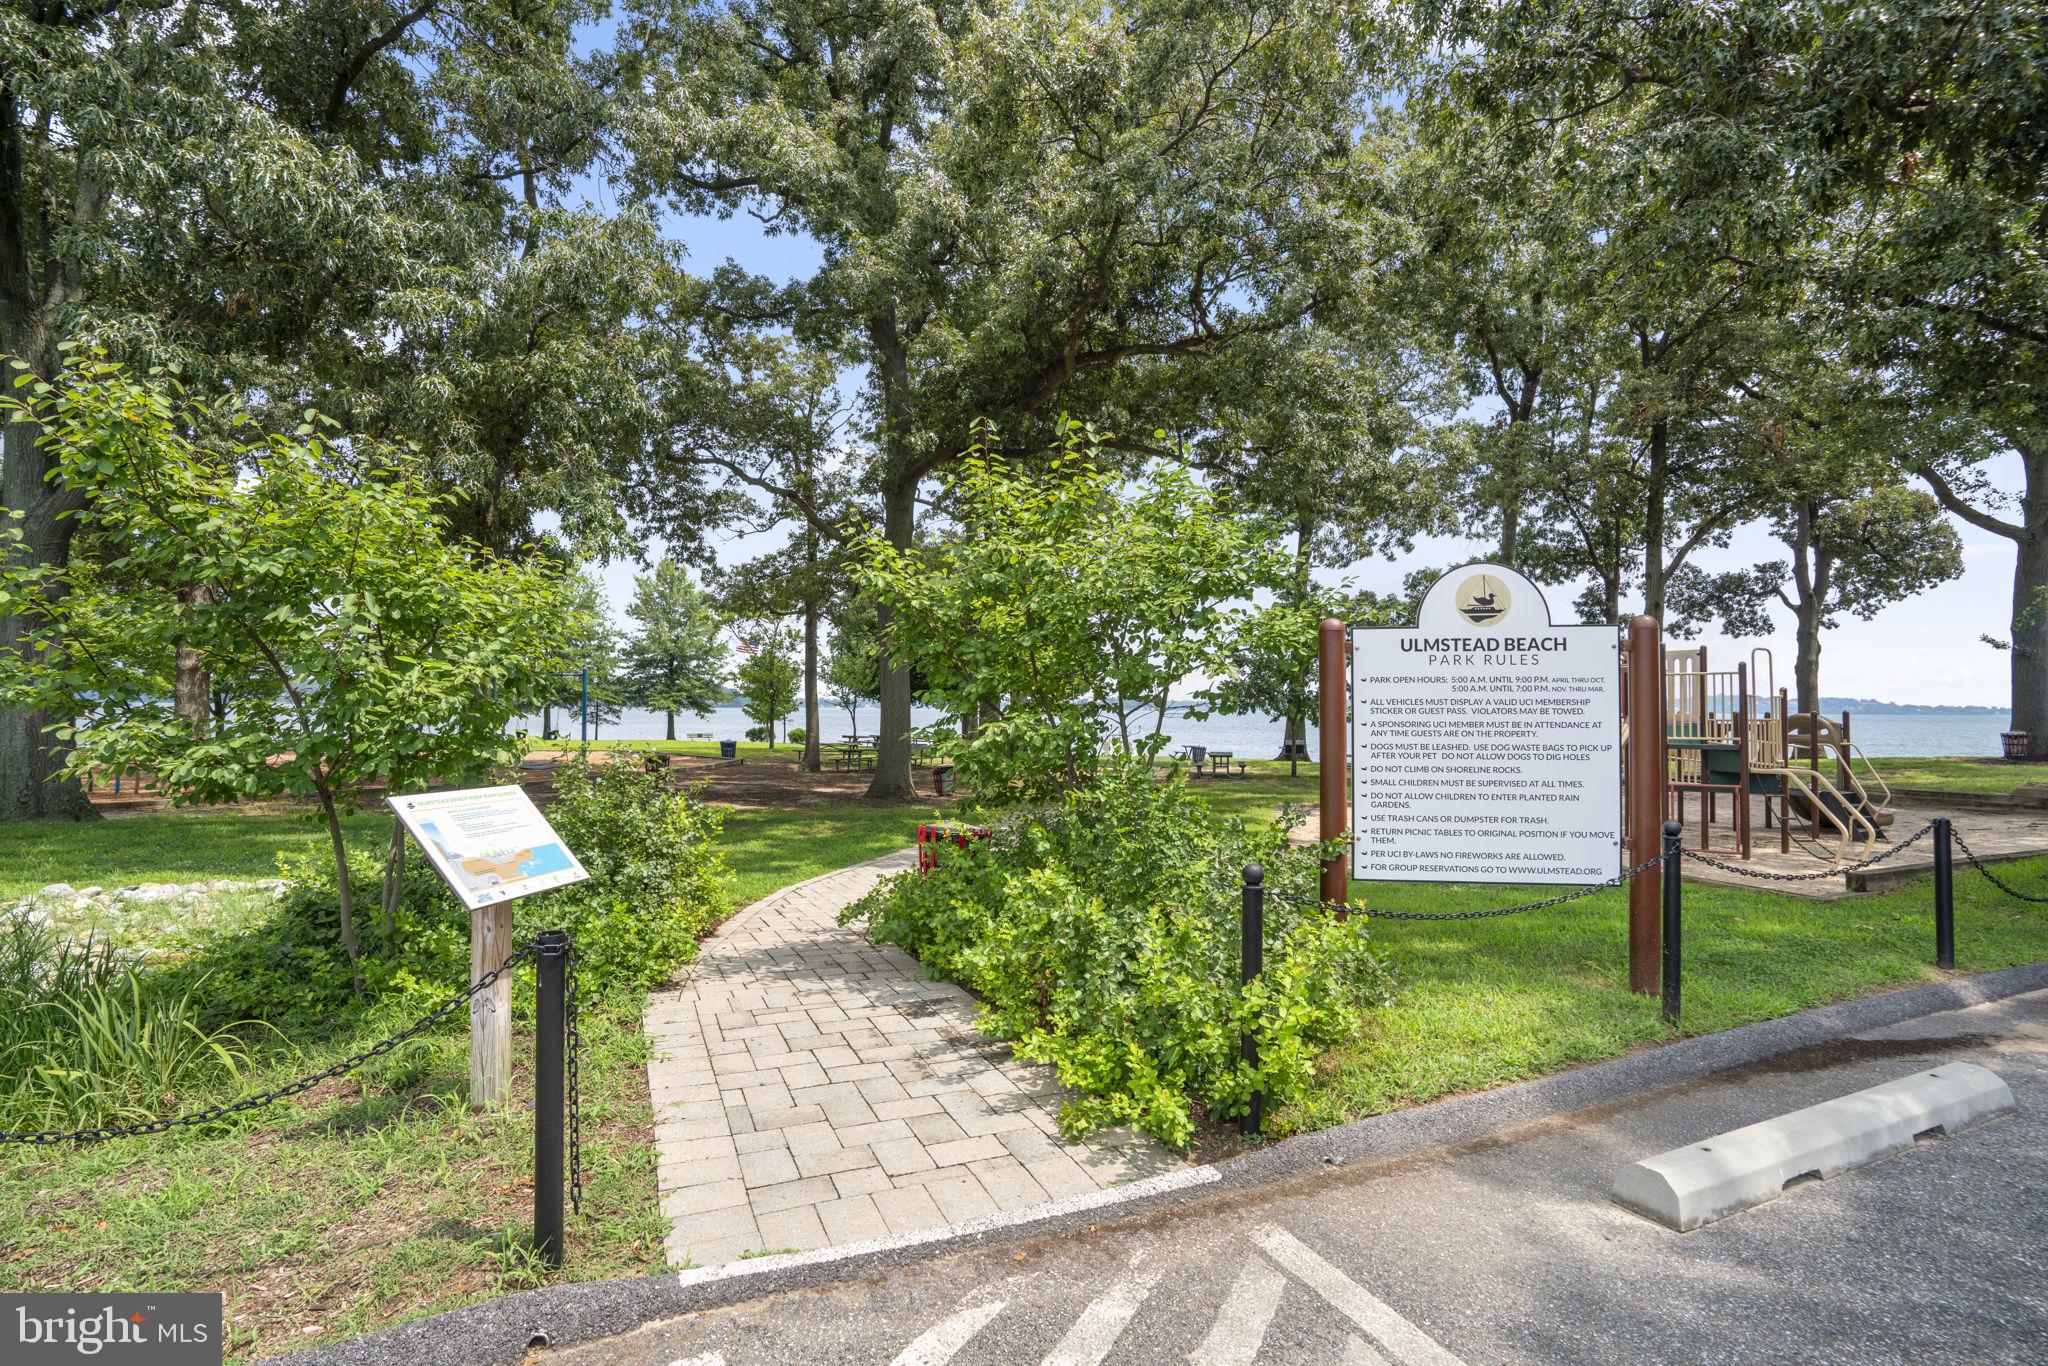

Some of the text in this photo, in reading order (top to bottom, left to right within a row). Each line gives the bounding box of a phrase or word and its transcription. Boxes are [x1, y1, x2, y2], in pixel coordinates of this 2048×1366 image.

[1400, 637, 1567, 652] ULMSTEAD BEACH
[1428, 654, 1539, 666] PARK RULES
[1533, 676, 1550, 684] P.M.
[1477, 779, 1528, 787] SUPERVISED
[1518, 793, 1557, 801] PLANTED
[1453, 815, 1499, 823] DUMPSTER
[1477, 829, 1517, 837] ORIGINAL
[1454, 851, 1503, 860] FIREWORKS
[1522, 853, 1566, 861] ALLOWED.
[1419, 864, 1479, 872] RESERVATIONS
[1508, 866, 1602, 875] WWW.ULMSTEAD.ORG
